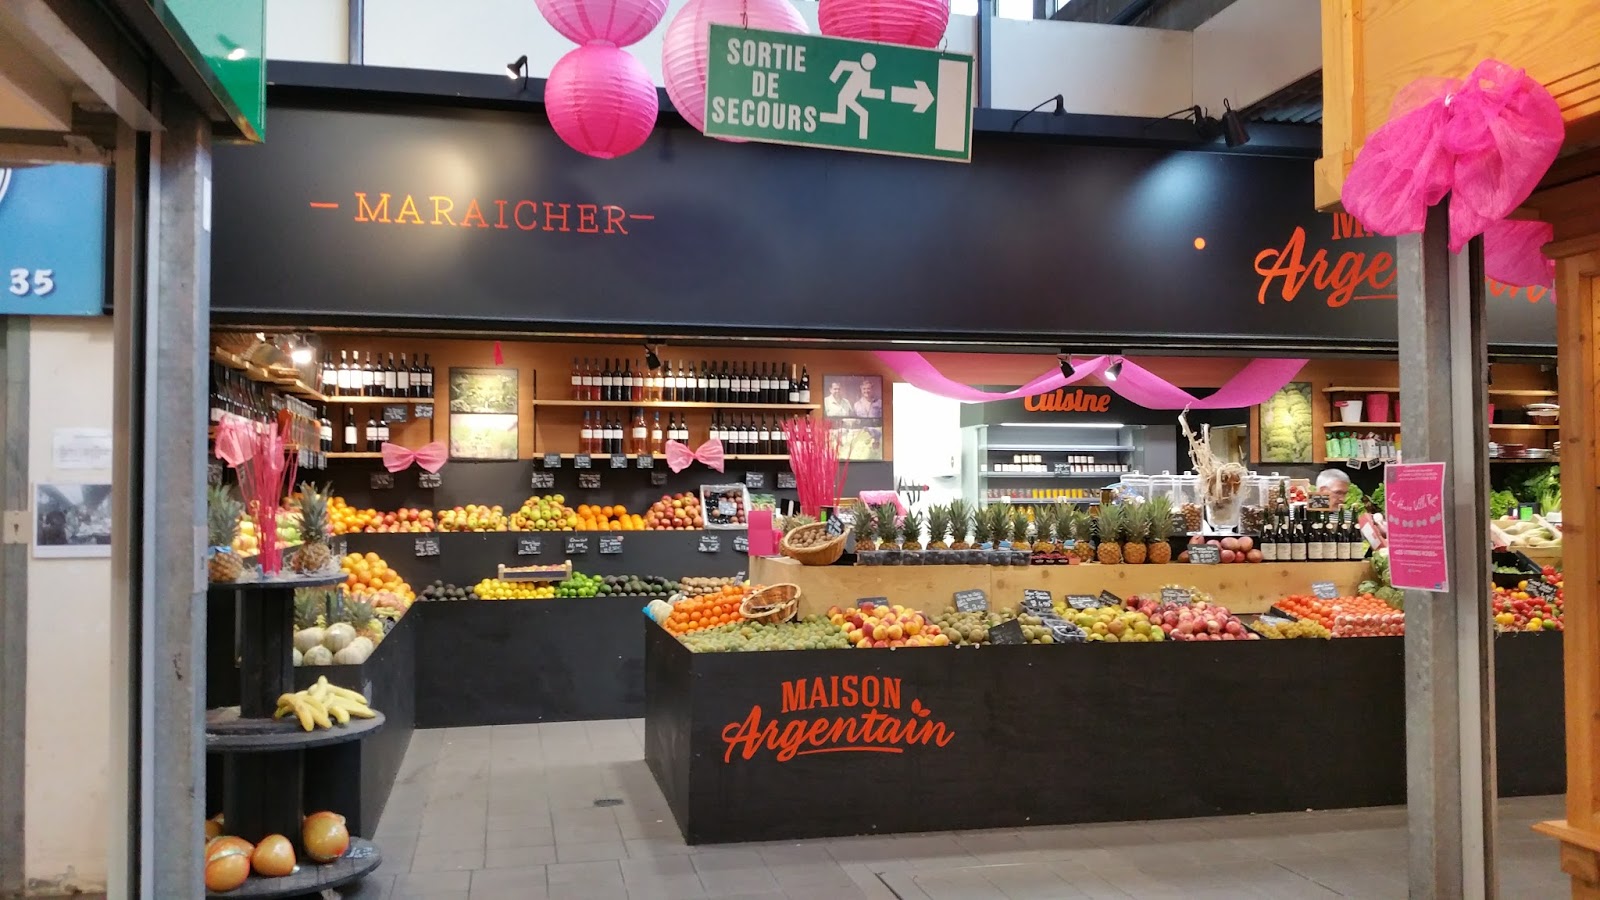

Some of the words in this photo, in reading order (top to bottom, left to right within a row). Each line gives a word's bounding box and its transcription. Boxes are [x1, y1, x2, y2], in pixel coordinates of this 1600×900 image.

[727, 38, 806, 73] SORTIE
[752, 71, 779, 99] DE
[712, 96, 817, 133] SECOURS
[354, 191, 628, 235] MARAICHER
[9, 268, 54, 296] 35
[1024, 388, 1111, 412] Cuisine
[781, 675, 901, 713] MAISON
[721, 704, 955, 764] Argentain
